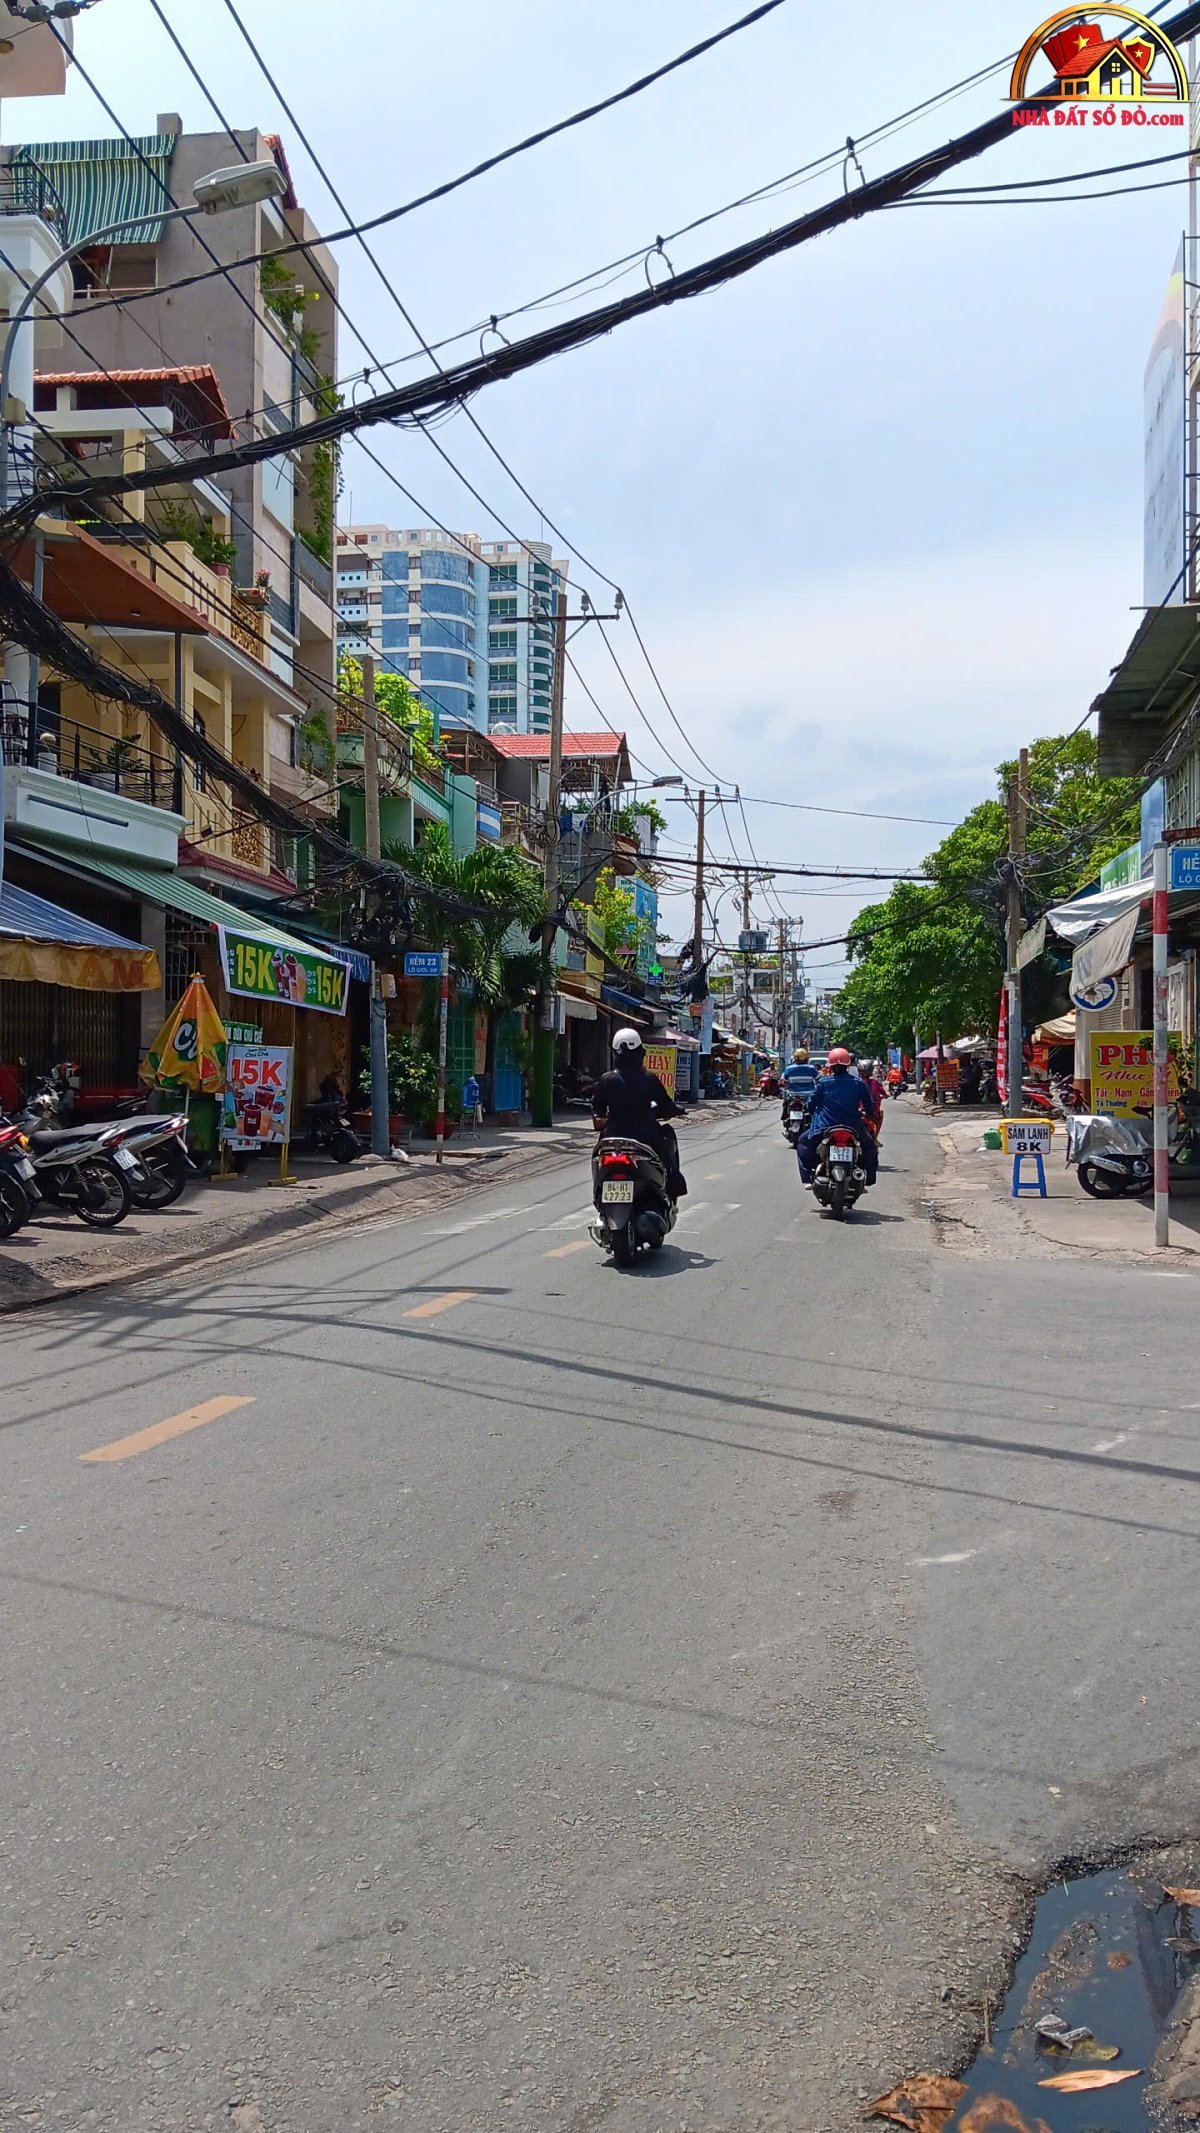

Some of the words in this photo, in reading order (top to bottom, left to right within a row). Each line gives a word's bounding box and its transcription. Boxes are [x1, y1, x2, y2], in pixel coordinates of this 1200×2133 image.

[236, 943, 276, 991] 15K
[427, 958, 437, 966] 23
[316, 964, 345, 1007] 15K
[231, 1058, 283, 1087] 15K
[1016, 1141, 1042, 1152] 8K
